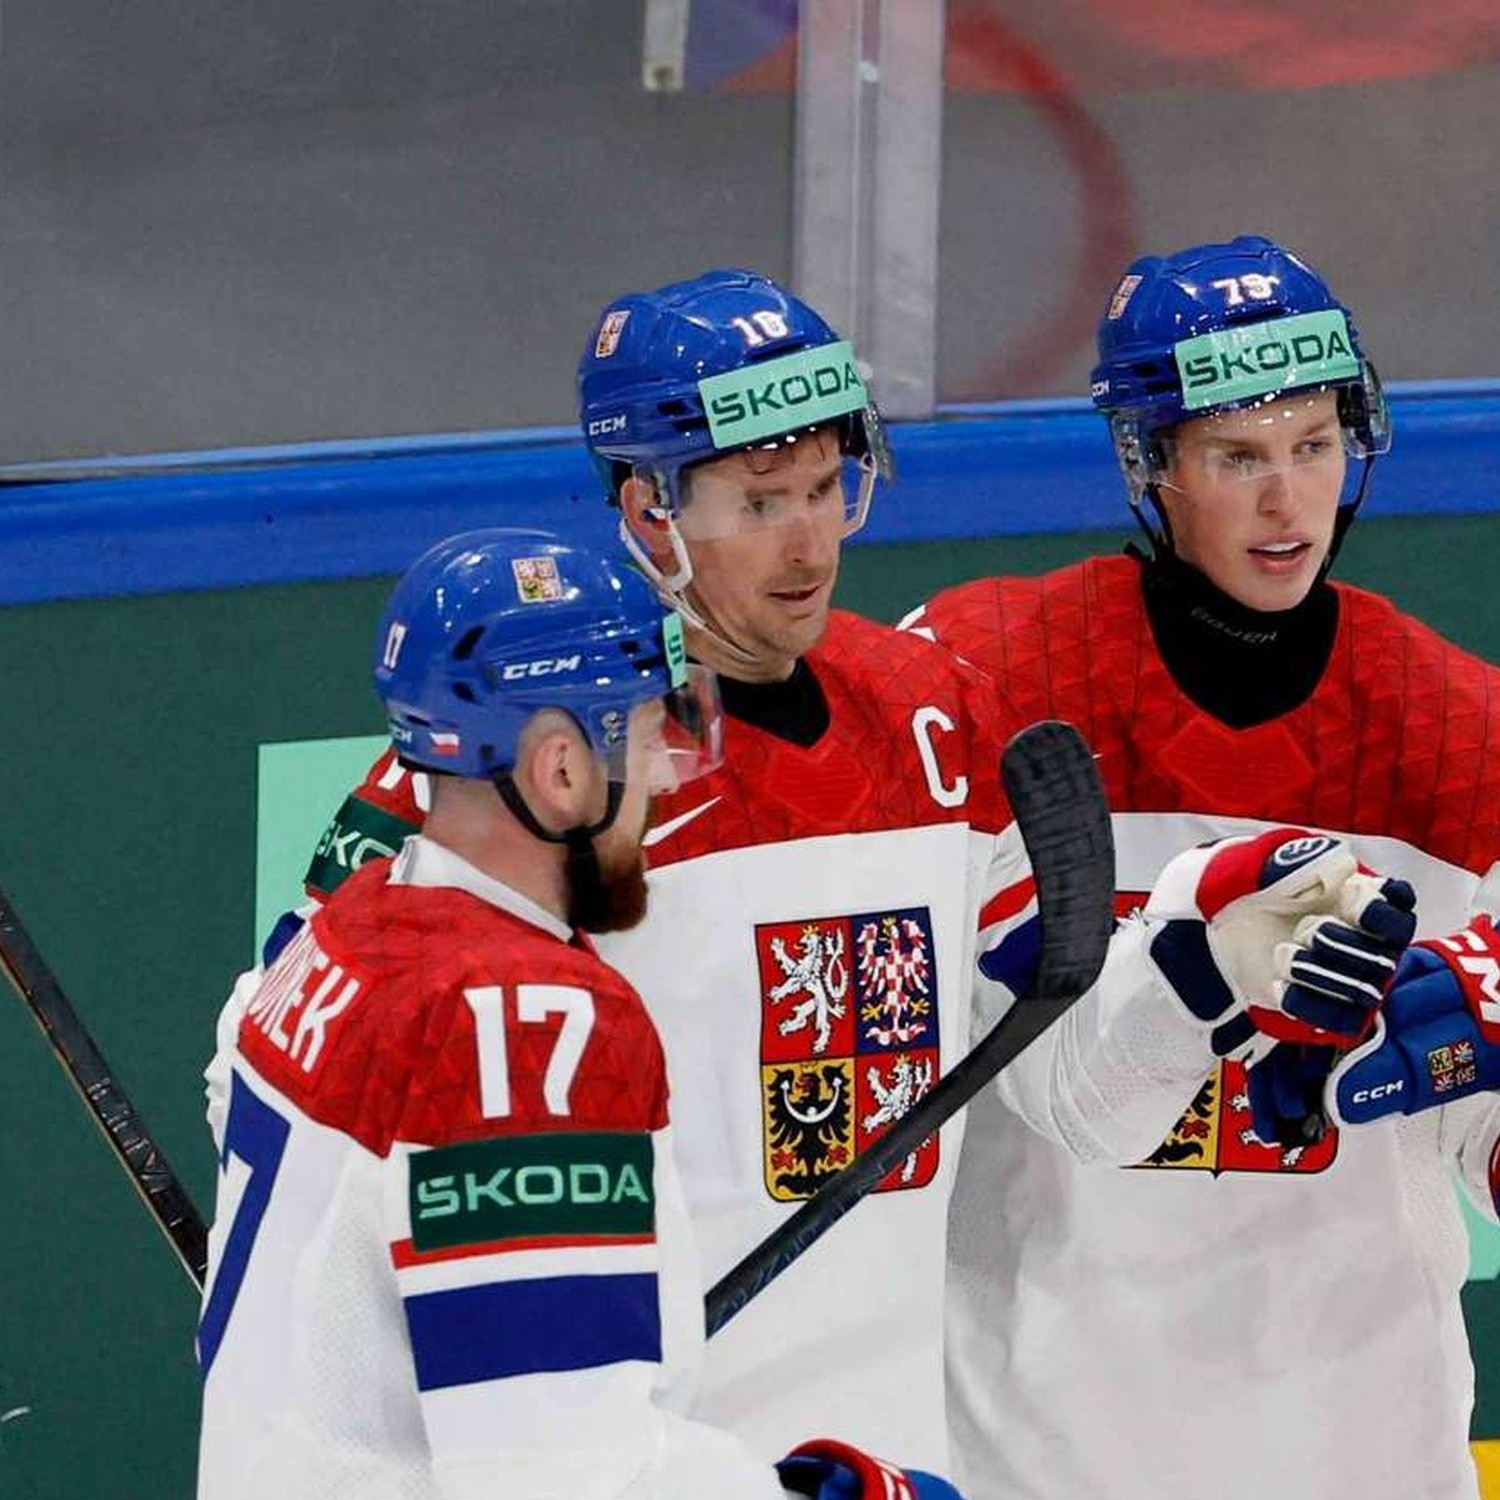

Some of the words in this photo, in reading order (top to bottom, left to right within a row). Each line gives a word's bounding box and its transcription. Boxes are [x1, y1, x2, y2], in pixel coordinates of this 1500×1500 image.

[589, 415, 627, 437] CCM
[504, 655, 581, 680] CCM
[912, 706, 969, 808] C
[464, 984, 596, 1120] 17
[1353, 1080, 1404, 1104] CCM
